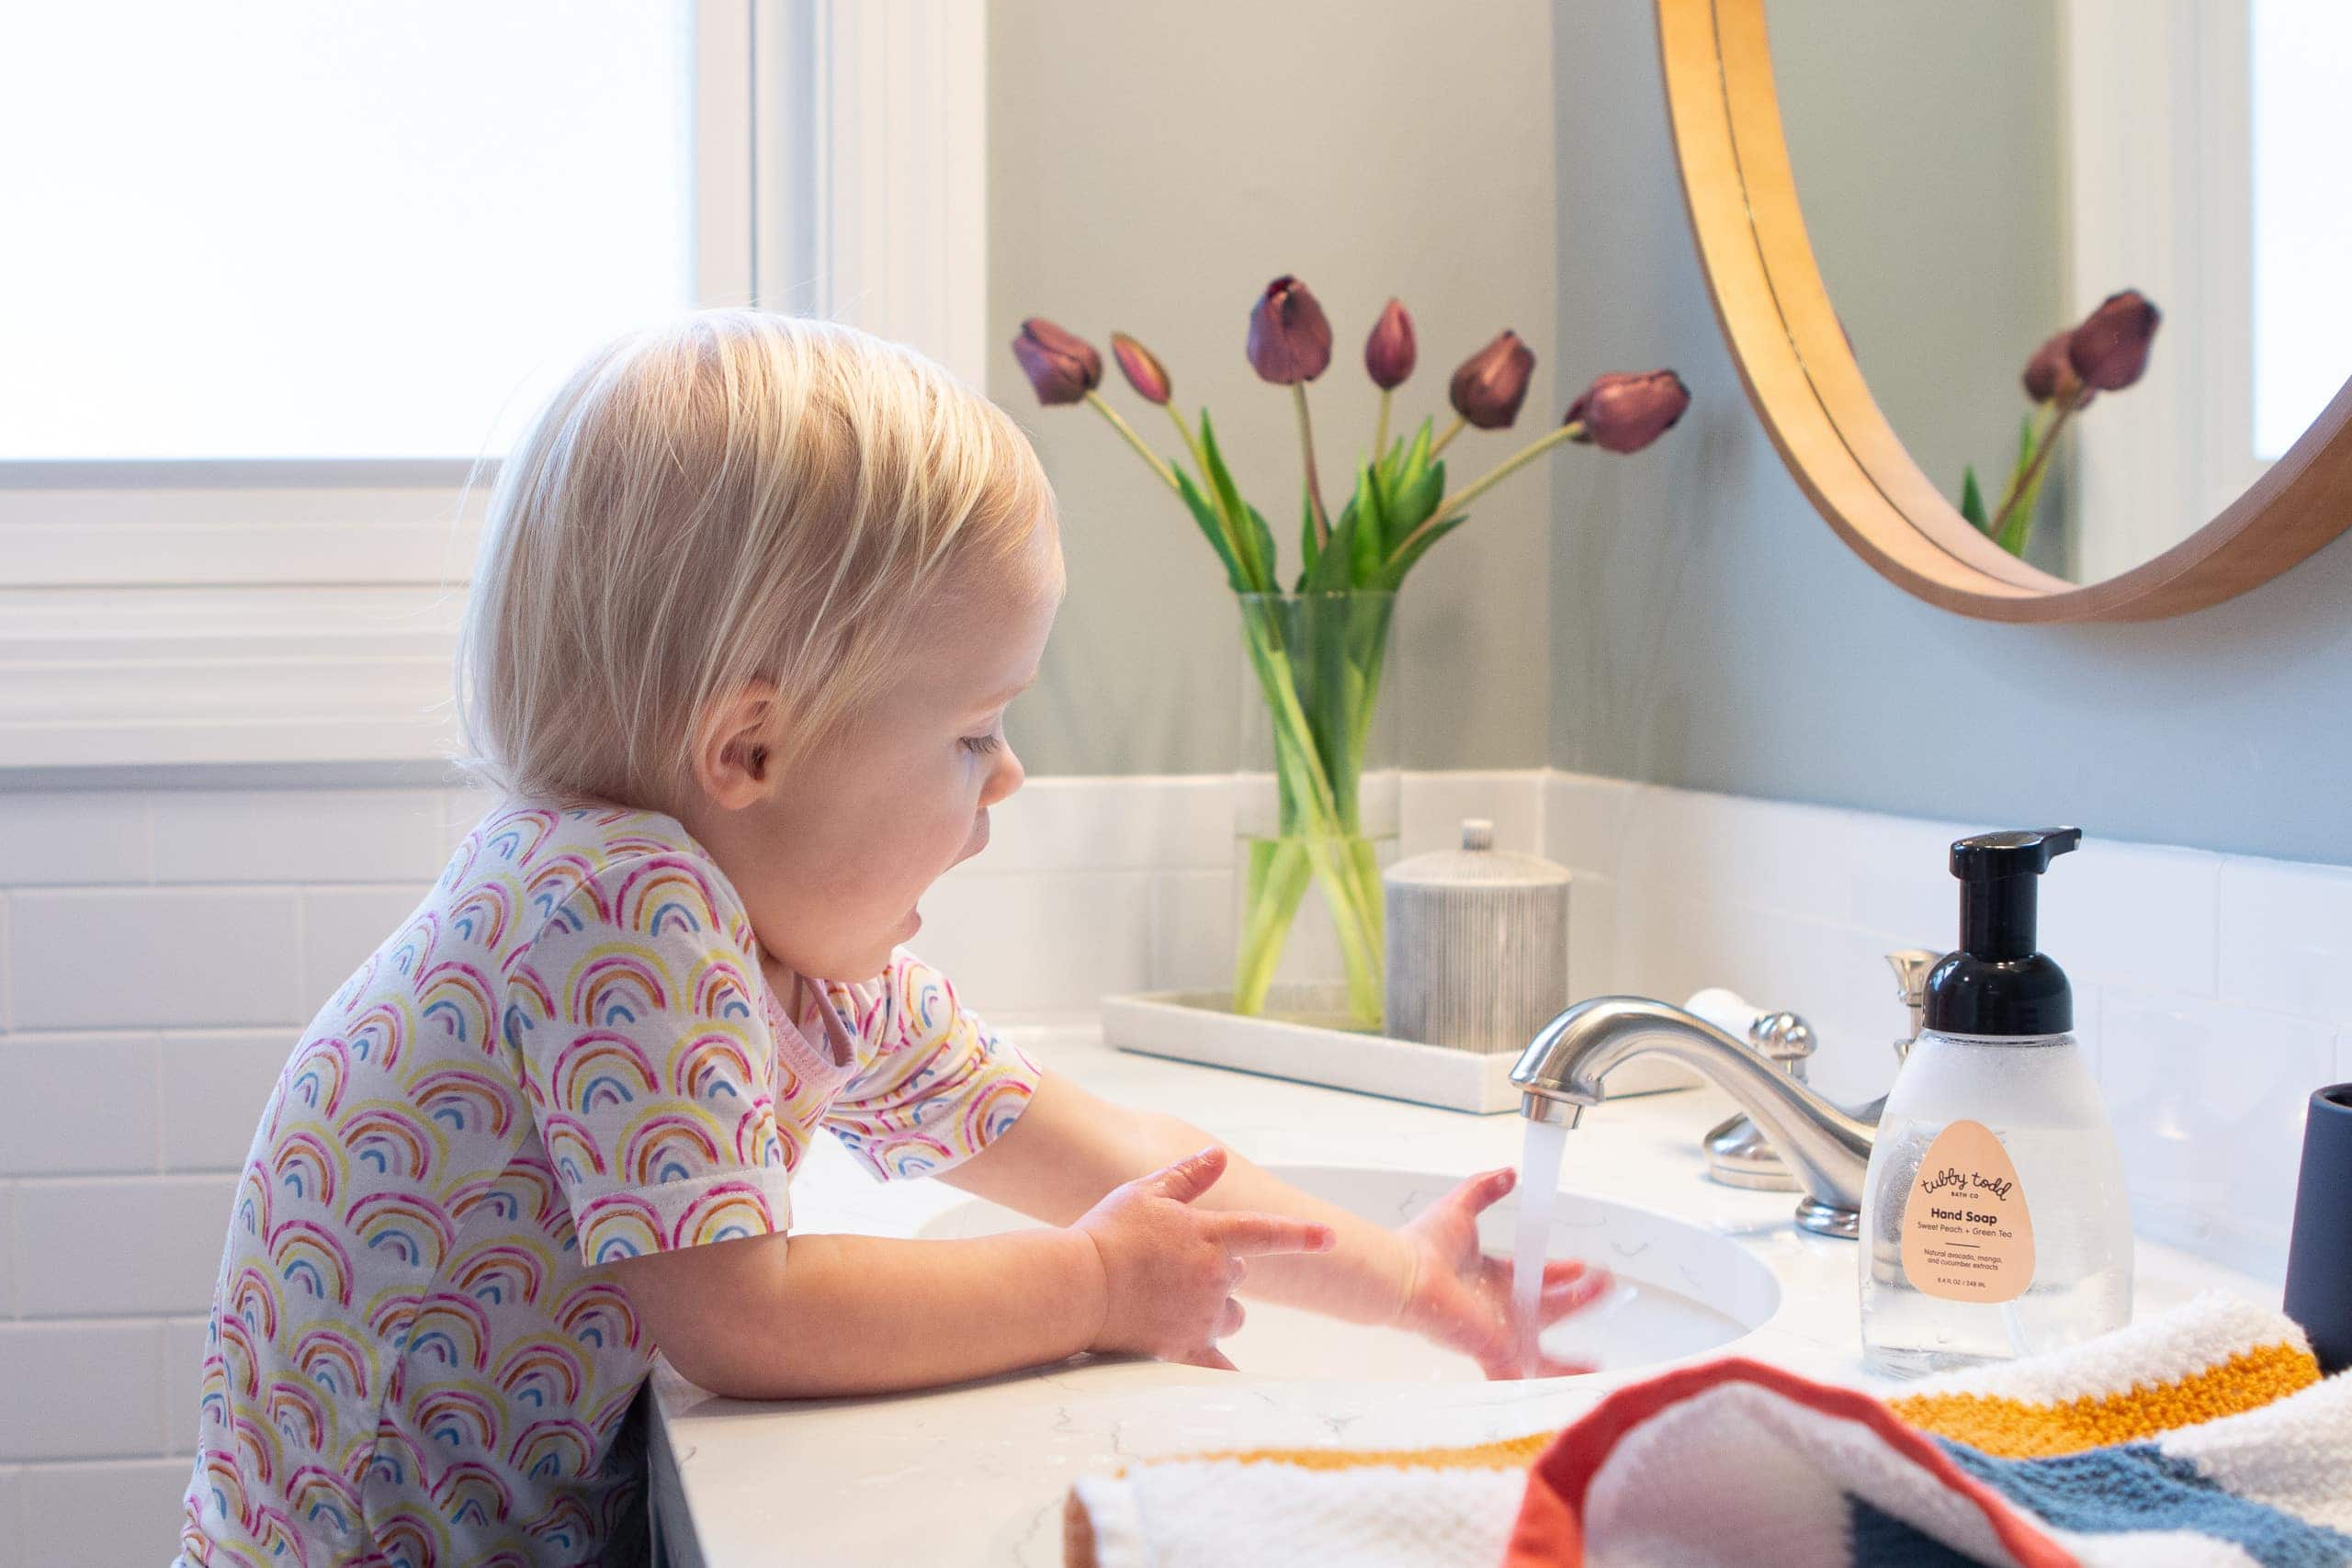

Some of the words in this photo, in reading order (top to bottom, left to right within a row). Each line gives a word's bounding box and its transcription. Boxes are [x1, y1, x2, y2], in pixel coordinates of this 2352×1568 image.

[1921, 1168, 1968, 1194] tubby
[1972, 1172, 2012, 1201] todd
[1931, 1208, 1962, 1221] Hand
[1966, 1212, 1997, 1226] Soap
[1917, 1222, 1939, 1231] Sweet
[1940, 1224, 1962, 1234] Peach
[1973, 1227, 1996, 1236] Green
[1998, 1230, 2012, 1238] Tea
[1924, 1248, 1946, 1258] Natural
[1948, 1252, 1975, 1261] avocado,
[1940, 1259, 1971, 1268] cucumber
